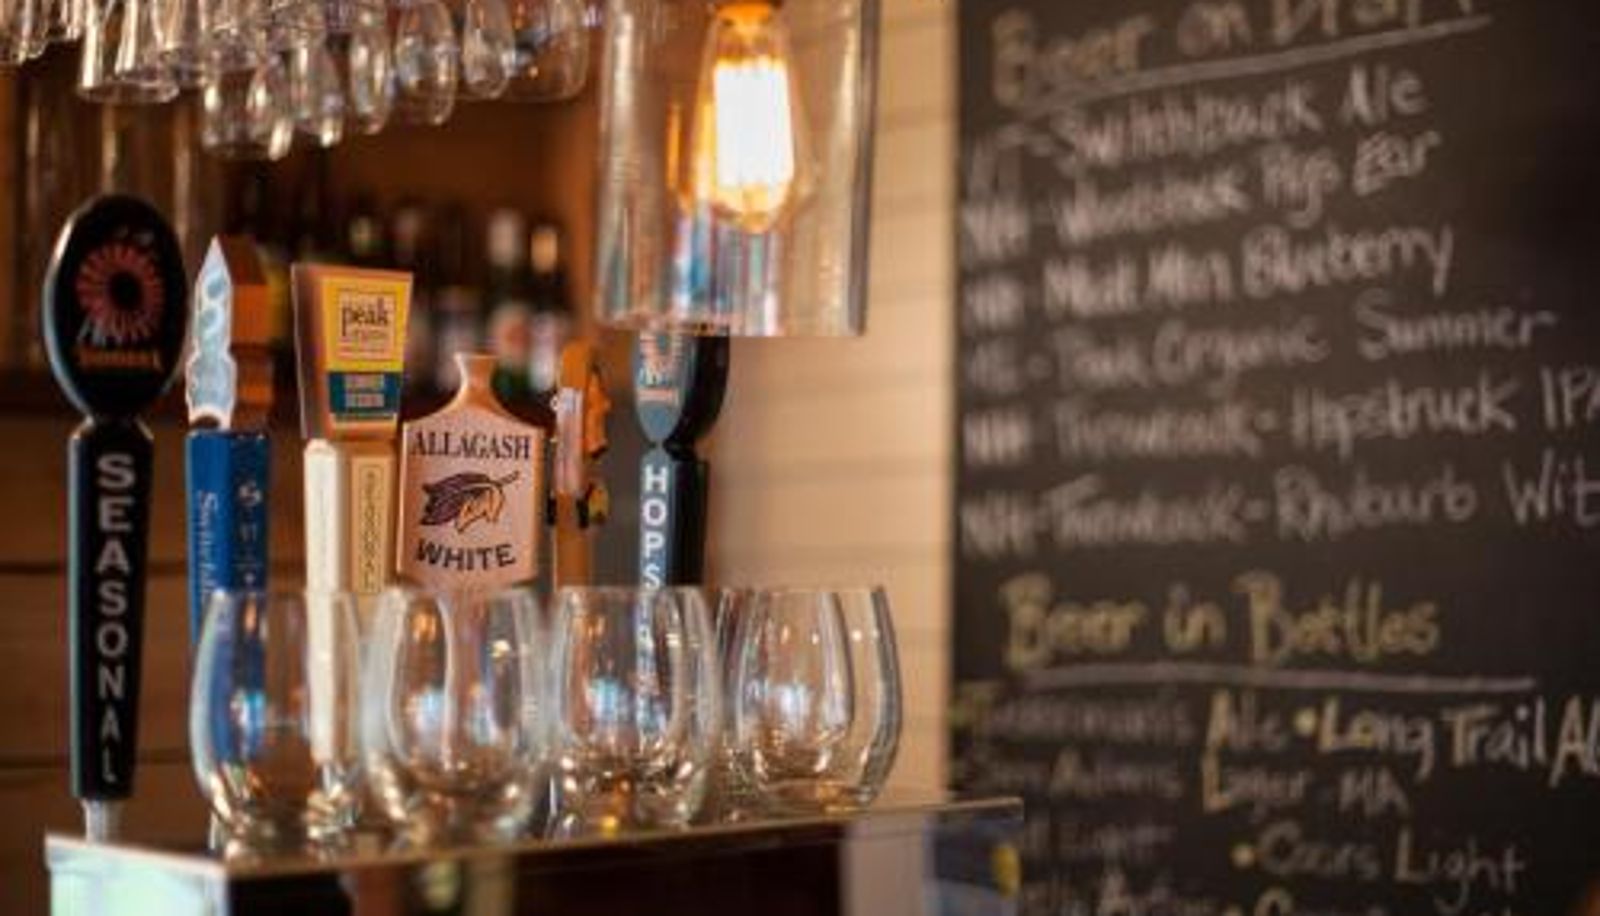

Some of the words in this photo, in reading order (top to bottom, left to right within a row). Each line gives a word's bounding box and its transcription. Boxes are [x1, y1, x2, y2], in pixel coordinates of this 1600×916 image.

[409, 431, 531, 460] ALLAGASH
[1501, 448, 1600, 528] Wit
[415, 538, 517, 571] WHITE
[95, 454, 137, 783] SEASONAL
[1001, 572, 1149, 671] Beer
[1163, 579, 1227, 654] in
[1233, 568, 1442, 667] Bottles
[1441, 696, 1548, 771] Trail
[1548, 695, 1600, 789] Al
